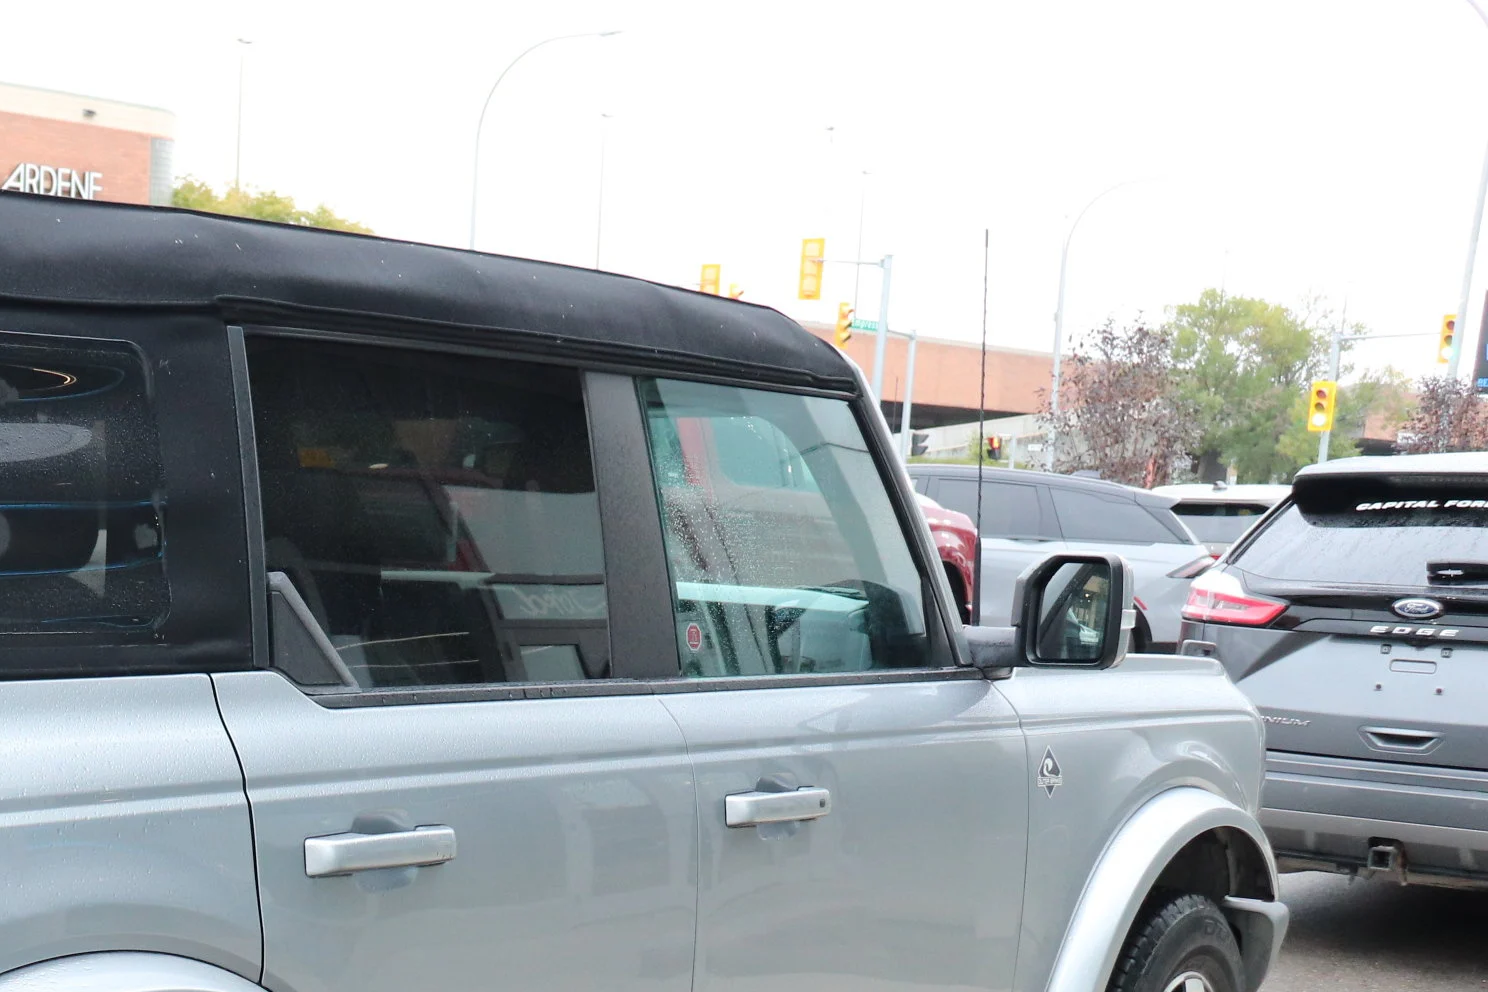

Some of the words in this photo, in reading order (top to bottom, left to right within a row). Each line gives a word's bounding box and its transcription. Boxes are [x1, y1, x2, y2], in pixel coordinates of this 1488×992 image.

[1, 162, 104, 200] ARDENE
[1356, 501, 1440, 511] CAPITAL
[1370, 626, 1459, 637] EDGE
